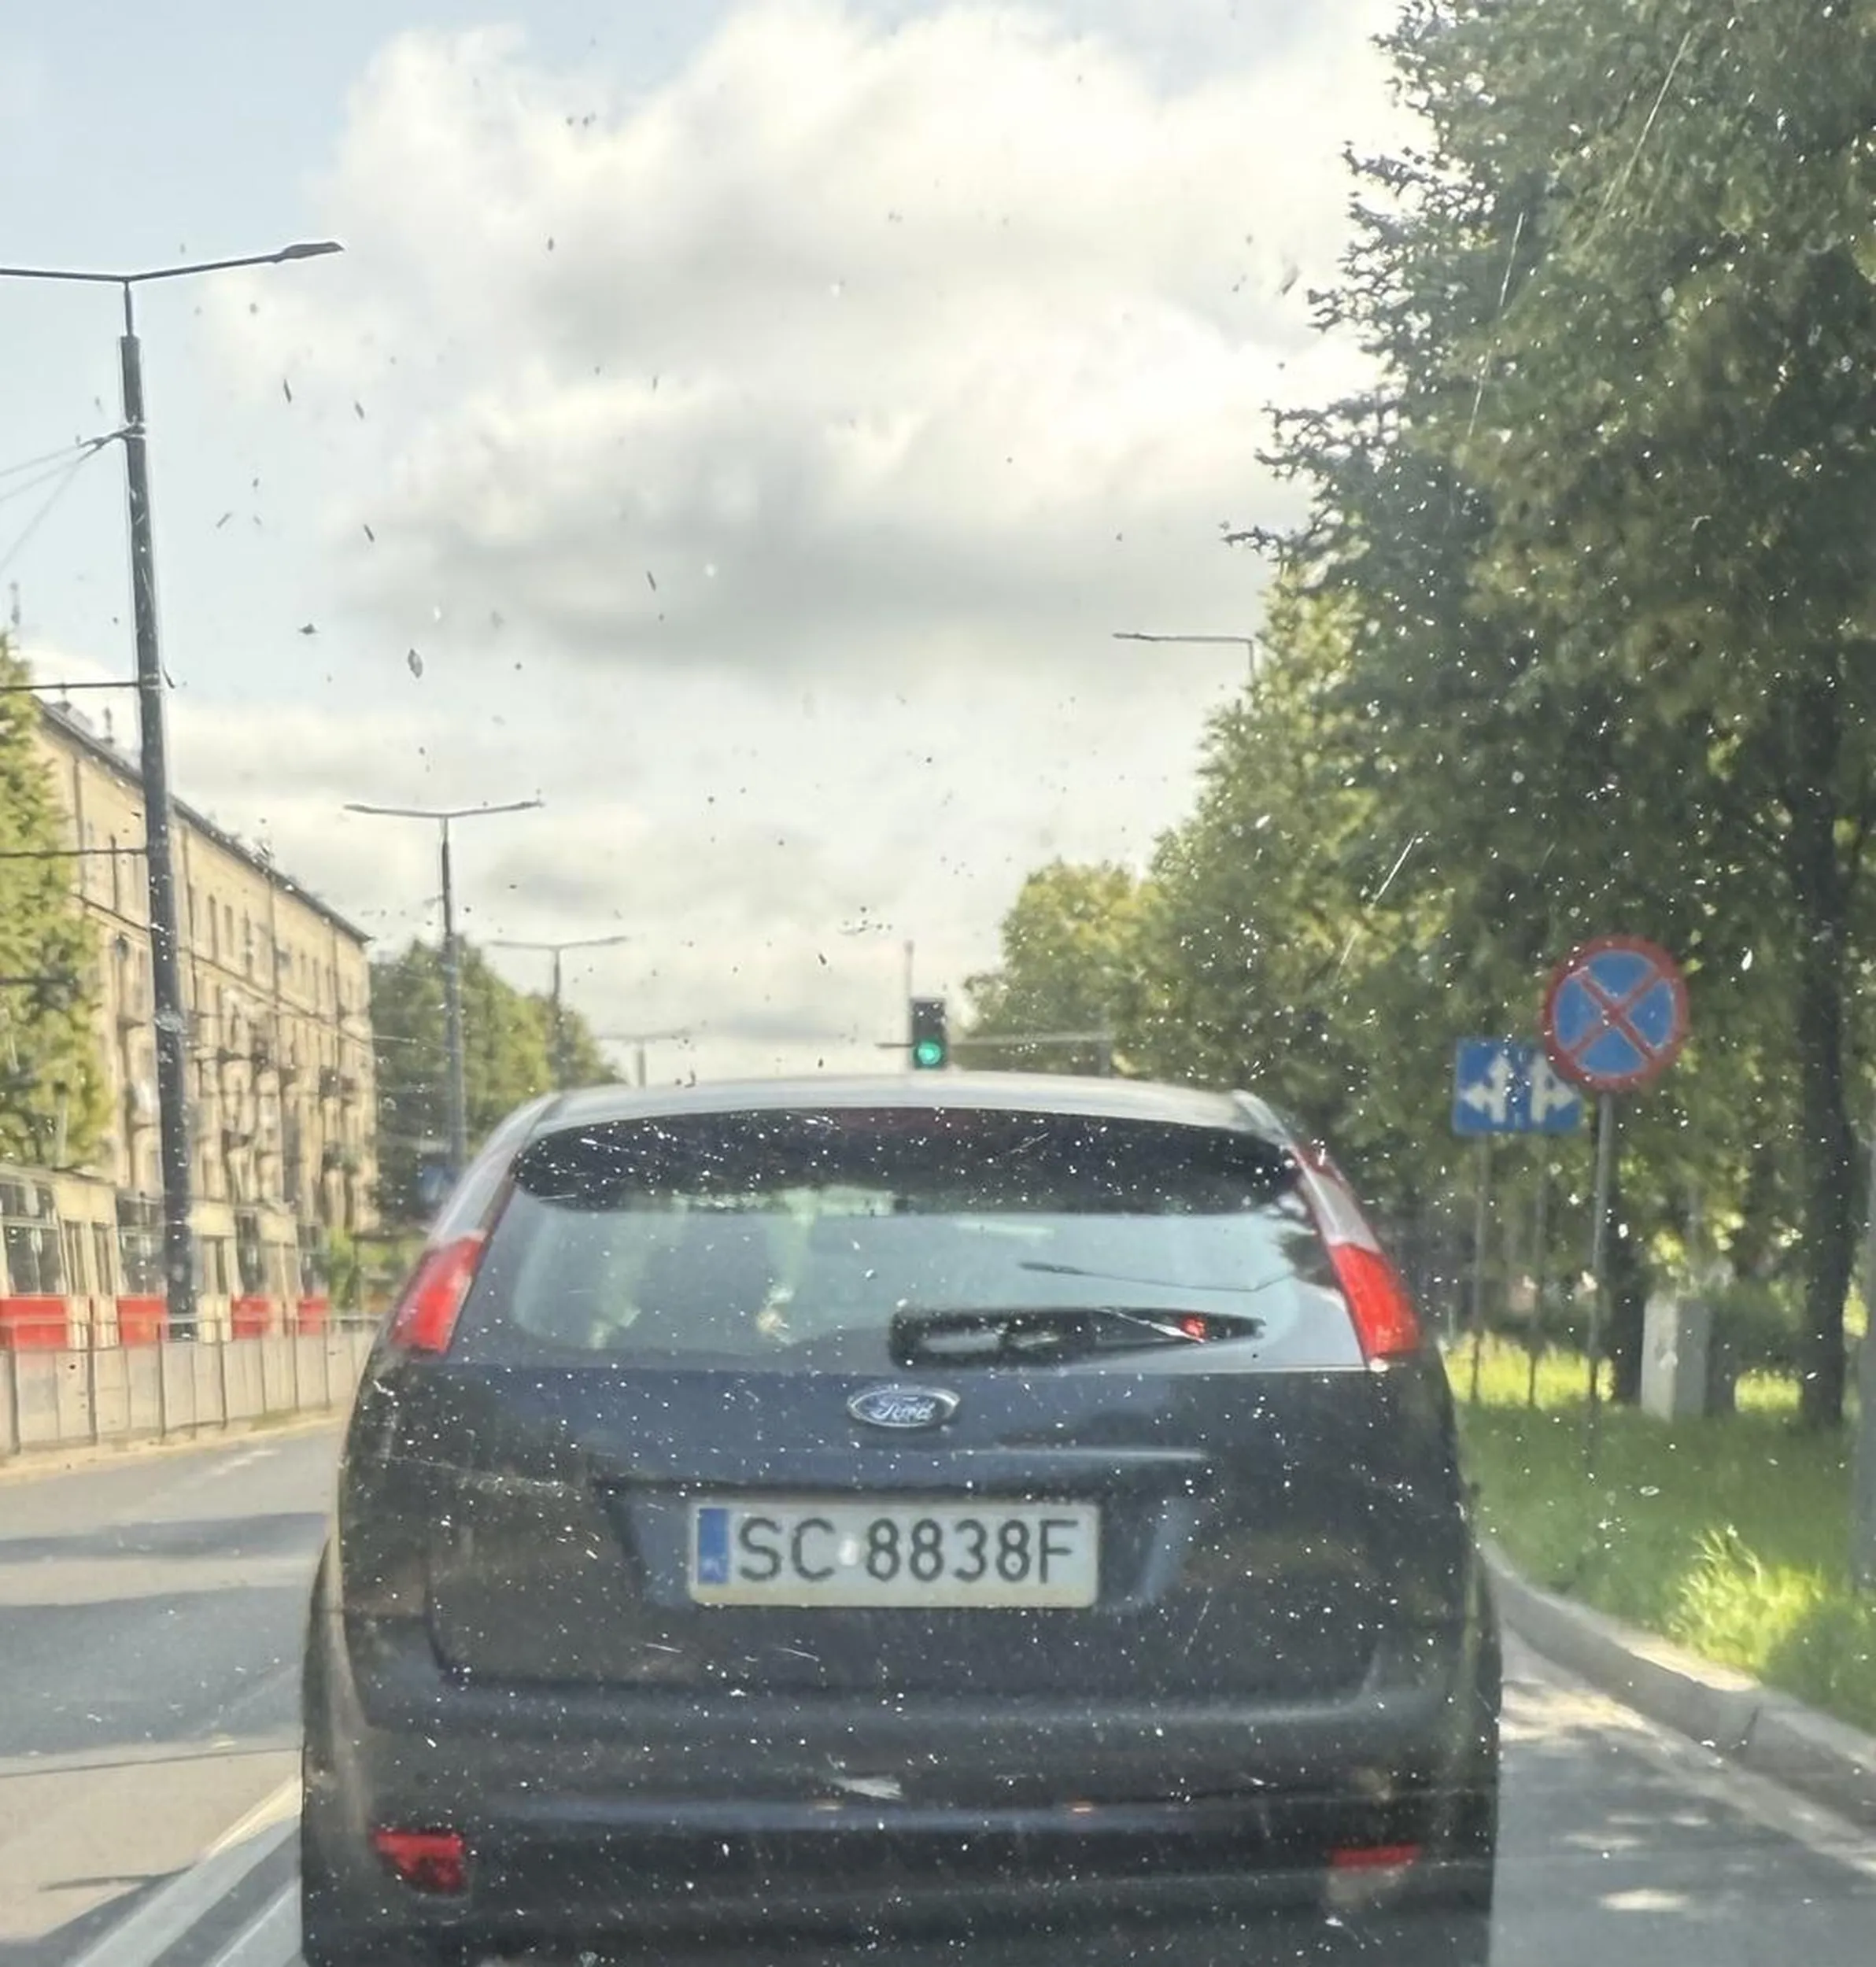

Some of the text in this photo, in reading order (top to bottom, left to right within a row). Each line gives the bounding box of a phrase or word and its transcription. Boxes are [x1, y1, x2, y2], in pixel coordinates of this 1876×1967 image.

[869, 1396, 936, 1422] Ford
[738, 1517, 1078, 1583] SC 8838F
